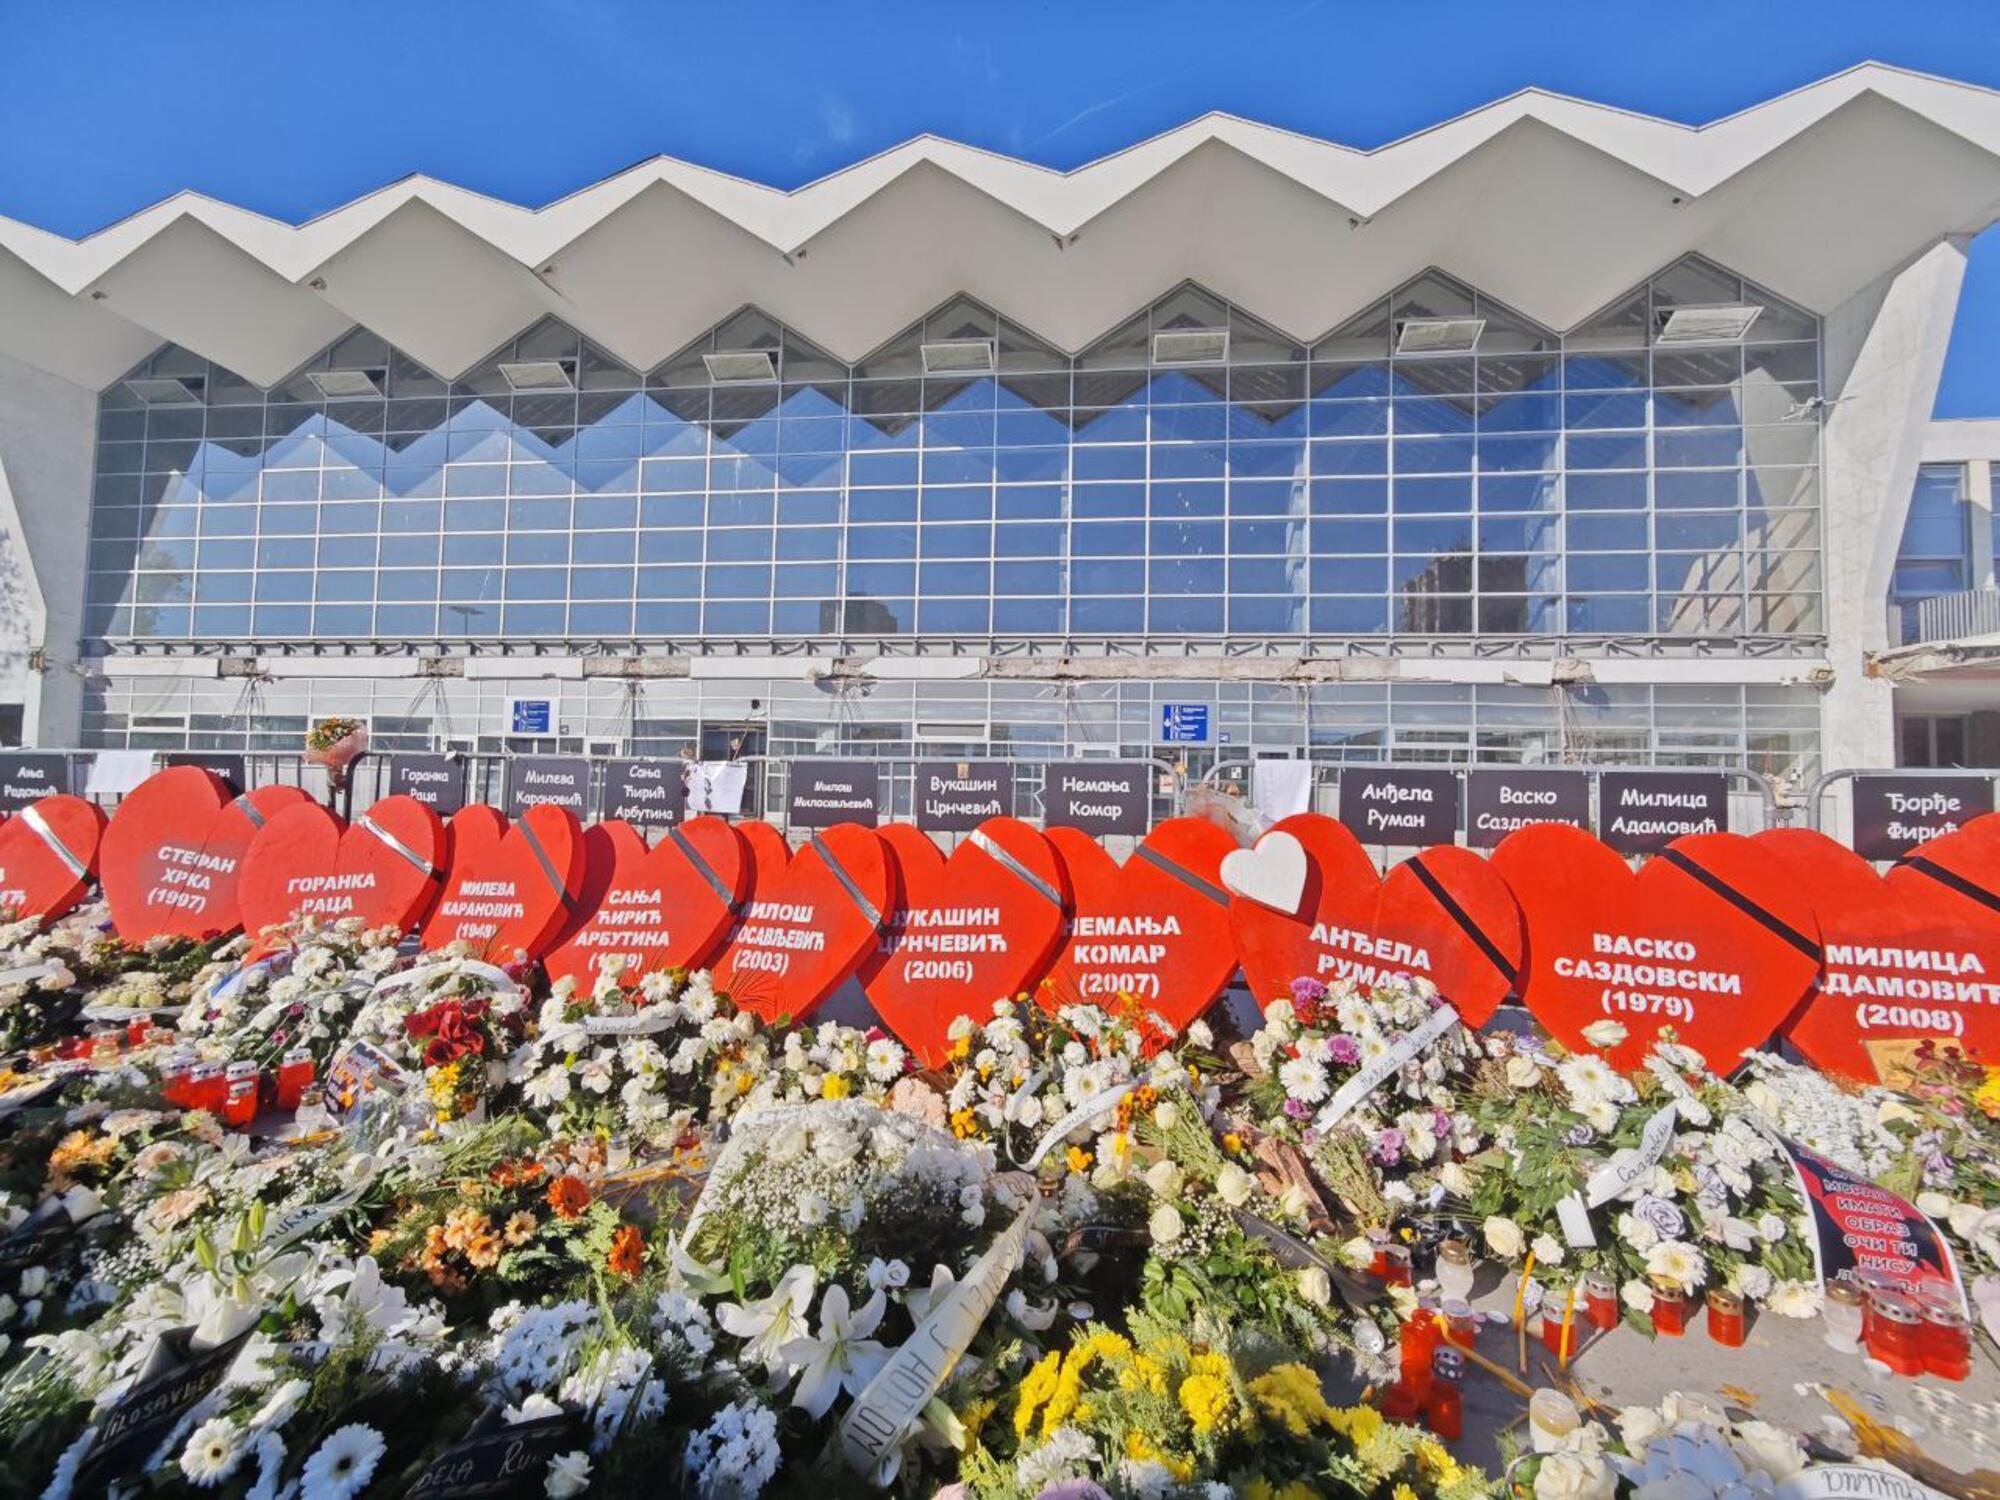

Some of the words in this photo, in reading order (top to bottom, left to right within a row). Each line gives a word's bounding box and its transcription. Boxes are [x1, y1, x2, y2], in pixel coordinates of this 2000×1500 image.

[402, 767, 449, 783] Горанка
[525, 770, 575, 786] Милева
[629, 766, 661, 779] Сања
[410, 789, 438, 802] Раца
[624, 787, 666, 801] Ћирић
[814, 781, 853, 793] Милош
[929, 777, 998, 793] Вукашин
[1062, 776, 1131, 795] Немања
[1362, 782, 1434, 803] Анђела
[1500, 786, 1557, 804] Васко
[516, 790, 583, 807] Карановић
[925, 799, 1002, 817] Црнчевић
[1620, 788, 1708, 809] Милица
[1885, 792, 1962, 816] Ђорђе
[615, 805, 674, 822] Арбутина
[1069, 802, 1123, 821] Комар
[1367, 809, 1426, 832] Руман
[1610, 816, 1718, 836] Адамовић
[1886, 822, 1959, 844] Фирић
[158, 846, 236, 874] СТЕФАН
[161, 868, 211, 890] ХРКА
[287, 873, 376, 894] ГОРАНКА
[459, 881, 516, 897] МИЛЕВА
[148, 888, 207, 914] (1997)
[301, 896, 353, 914] РАЦА
[608, 889, 662, 904] САЊА
[441, 901, 524, 918] КАРАНОВИЋ
[598, 910, 662, 925] ЋИРИЋ
[1064, 915, 1182, 937] НЕМАЊА
[575, 930, 670, 947] АРБУТИНА
[879, 933, 1008, 954] ЦРНЧЕВИЋ
[1308, 922, 1432, 971] АНЂЕЛА
[1593, 933, 1696, 962] ВАСКО
[588, 952, 644, 973] (19)
[732, 949, 790, 978] (2003)
[1073, 944, 1167, 965] КОМАР
[1825, 944, 1986, 976] МИЛИЦА
[903, 960, 974, 984] (2006)
[1316, 953, 1394, 990] РУМА
[1554, 957, 1741, 995] САЗДОВСКИ
[1079, 972, 1161, 999] (2007)
[1601, 989, 1694, 1023] (1979)
[1856, 1003, 1964, 1037] (2008)
[1843, 1233, 1887, 1253] ОЧИ
[1889, 1240, 1918, 1258] ТИ
[1858, 1254, 1917, 1275] НИСУ
